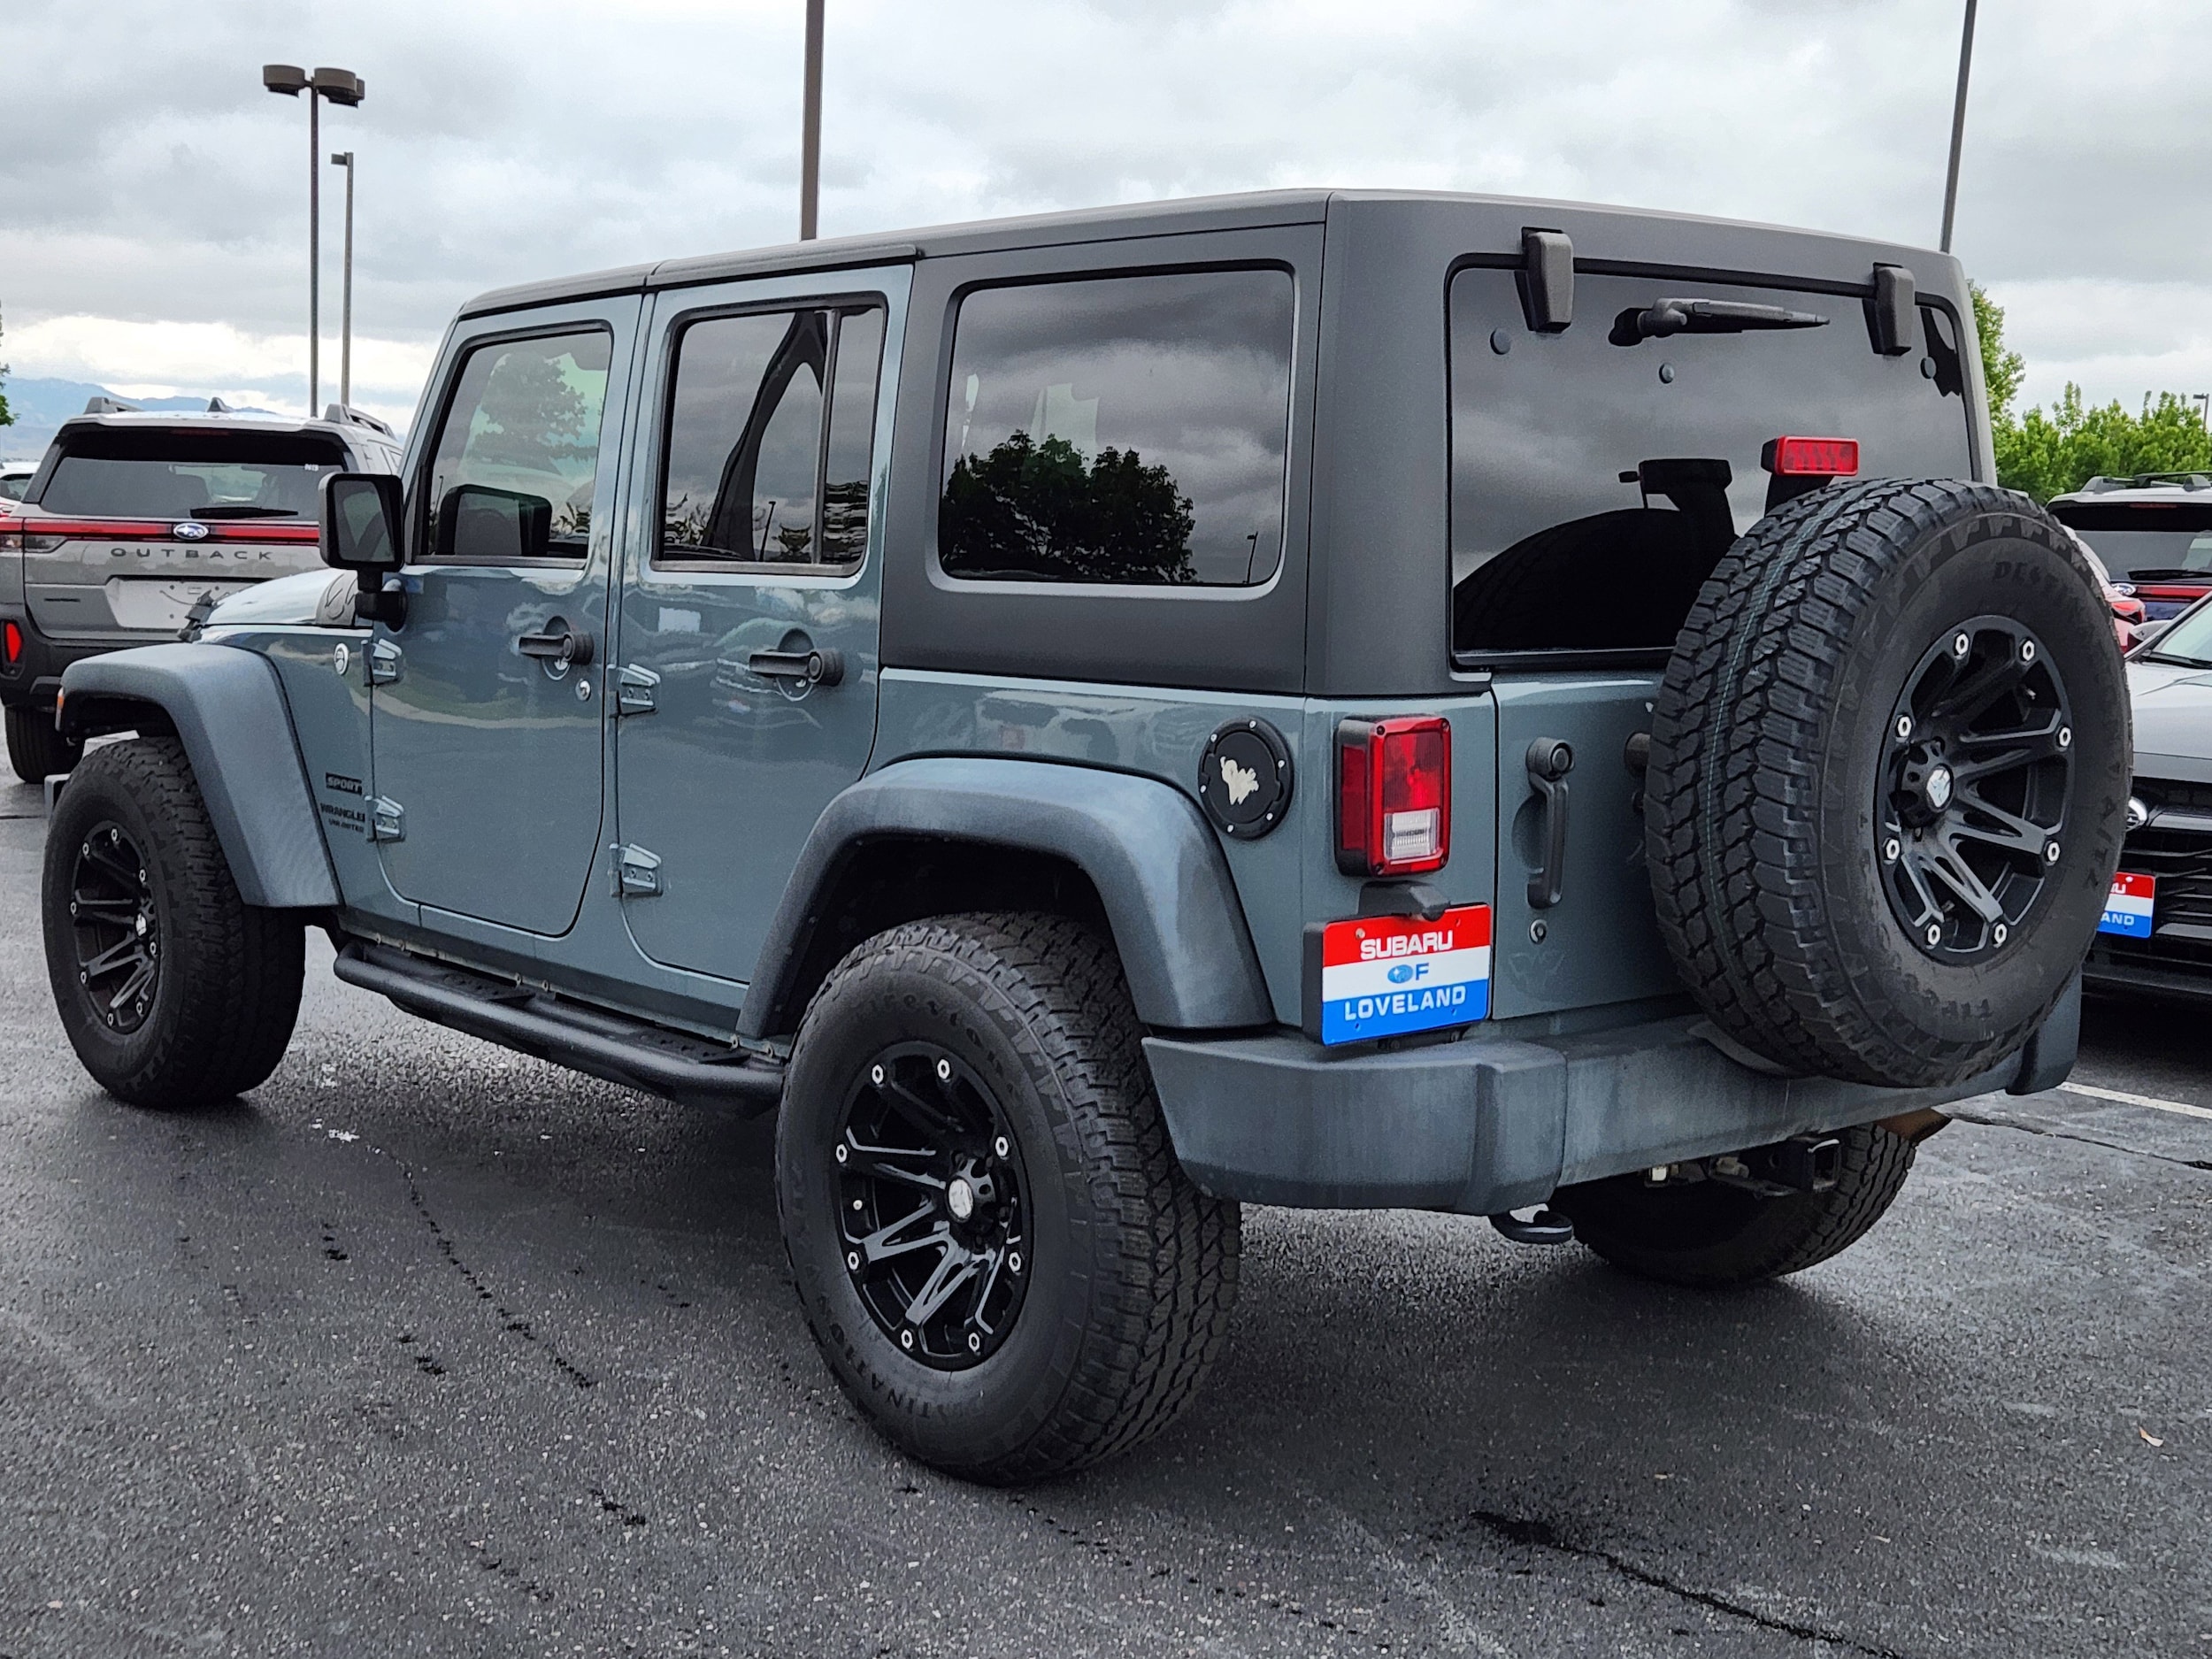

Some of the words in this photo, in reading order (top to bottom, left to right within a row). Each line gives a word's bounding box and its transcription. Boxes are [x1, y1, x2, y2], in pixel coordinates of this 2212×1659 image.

[110, 547, 273, 560] OUTBACK
[326, 775, 361, 793] SPORT
[1360, 929, 1454, 961] SUBARU
[1386, 962, 1430, 984] OF
[1344, 985, 1467, 1021] LOVELAND
